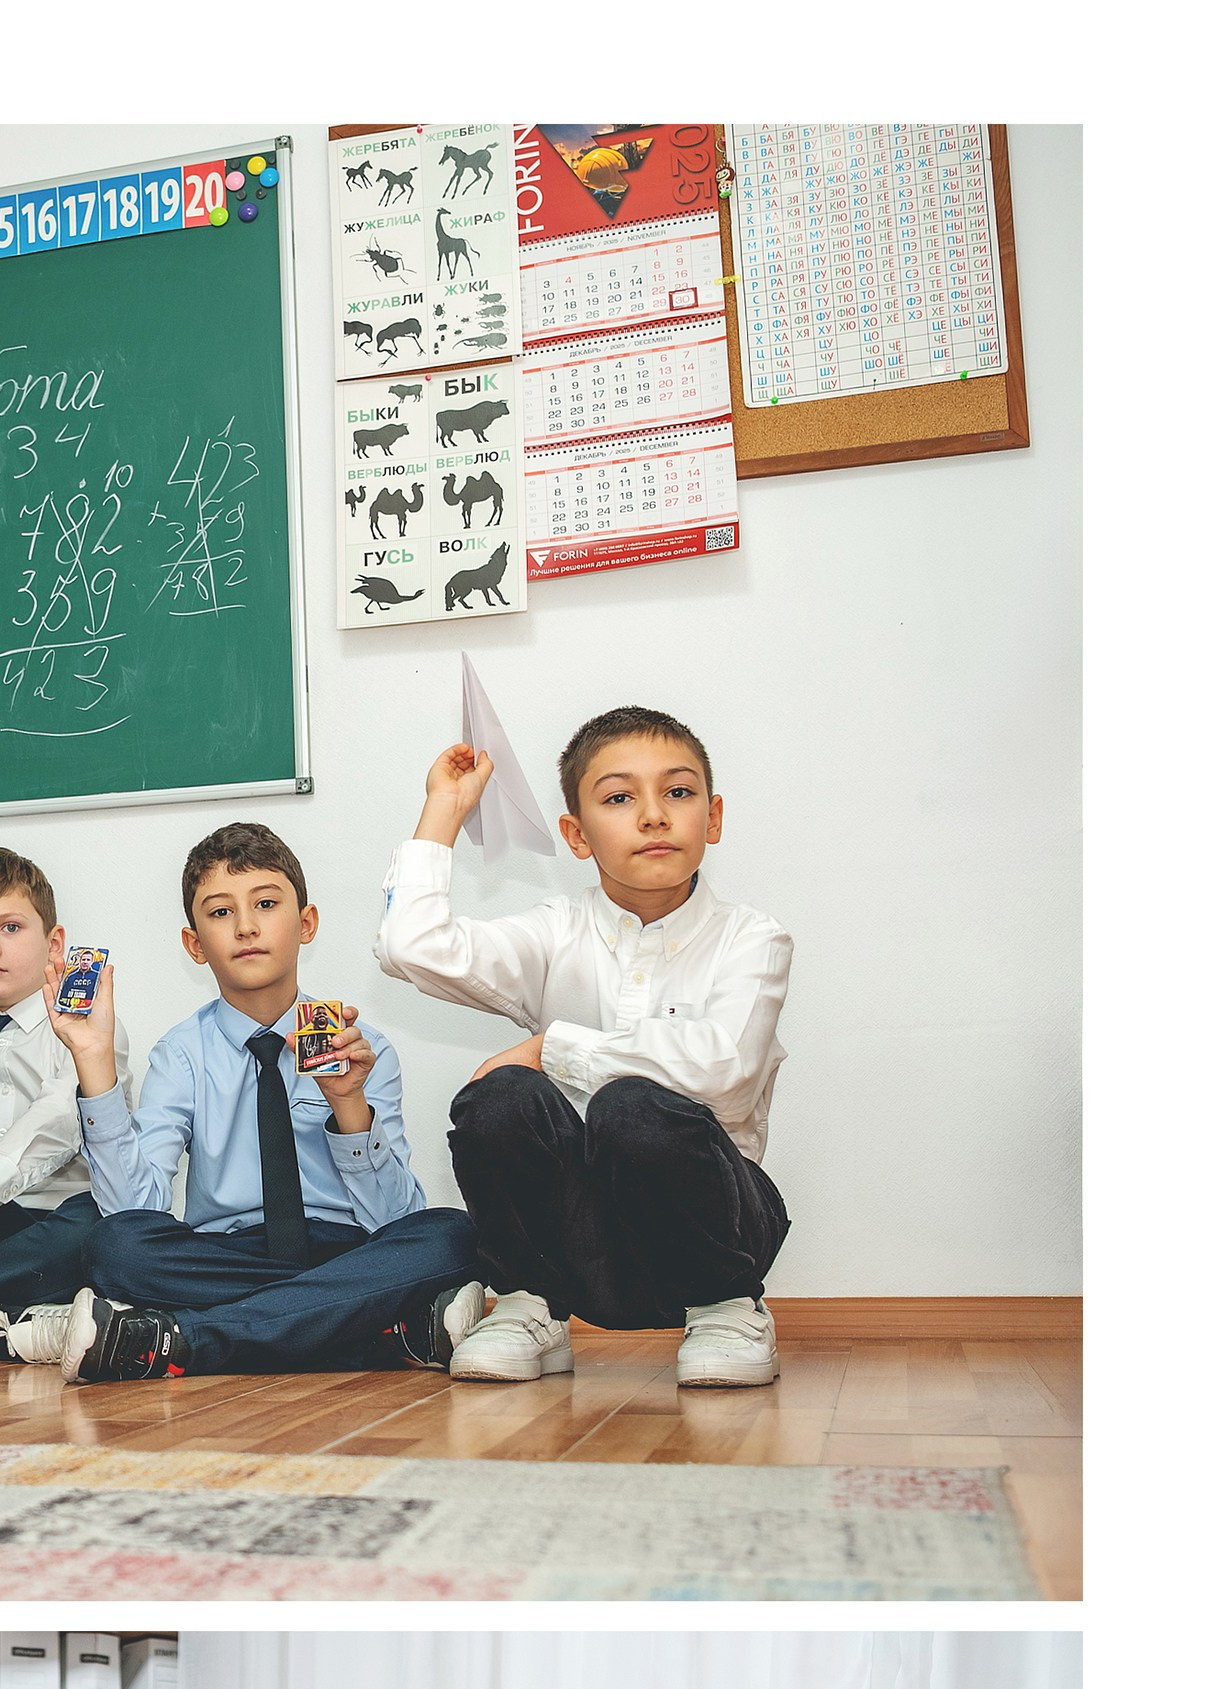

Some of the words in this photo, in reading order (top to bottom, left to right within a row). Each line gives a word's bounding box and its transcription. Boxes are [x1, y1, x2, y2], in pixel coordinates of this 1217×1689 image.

[425, 123, 501, 143] ЖЕРЕБЁНОК
[342, 137, 417, 158] ЖЕРЕБЯТА
[513, 123, 545, 235] FORIN
[21, 199, 58, 244] 16
[62, 192, 96, 237] 17
[103, 185, 139, 230] 18
[144, 178, 179, 223] 19
[184, 171, 224, 218] 20
[343, 212, 422, 234] ЖУЖЕЛИЦА
[449, 210, 506, 230] ЖИРАФ
[627, 229, 667, 242] NOVEMBER
[752, 281, 759, 291] Р
[770, 278, 783, 287] РА
[792, 273, 805, 284] РЯ
[814, 270, 827, 280] РУ
[835, 266, 851, 277] РЮ
[858, 262, 873, 273] РО
[904, 255, 918, 265] РЭ
[927, 251, 940, 262] РЕ
[949, 248, 965, 258] РЫ
[973, 245, 987, 255] РИ
[444, 280, 489, 297] ЖУКИ
[753, 295, 760, 304] С
[771, 291, 785, 301] СА
[793, 287, 806, 297] СЯ
[815, 283, 828, 294] СУ
[836, 279, 852, 290] СЮ
[860, 276, 874, 286] СО
[905, 269, 919, 279] СЭ
[928, 265, 941, 275] СЕ
[950, 261, 966, 272] СЫ
[973, 258, 988, 269] СИ
[346, 292, 424, 314] ЖУРАВЛИ
[753, 308, 760, 318] Т
[773, 305, 786, 315] ТА
[794, 301, 807, 311] ТЯ
[816, 297, 829, 307] ТУ
[837, 293, 854, 304] ТЮ
[860, 289, 875, 300] ТО
[906, 282, 920, 292] ТЭ
[929, 278, 942, 289] ТЕ
[950, 275, 967, 286] ТЫ
[974, 272, 989, 282] ТИ
[753, 322, 763, 331] Ф
[772, 319, 788, 328] ФА
[794, 314, 810, 325] ФЯ
[816, 310, 832, 321] ФУ
[837, 306, 855, 318] ФЮ
[860, 303, 878, 314] ФО
[906, 296, 922, 306] ФЭ
[929, 292, 945, 303] ФЕ
[951, 289, 969, 300] ФЫ
[974, 286, 992, 296] ФИ
[569, 348, 602, 359] ДЕКАБРЬ
[634, 335, 673, 346] DECEMBER
[444, 373, 499, 396] БЫК
[347, 406, 400, 424] БЫКИ
[435, 450, 511, 469] ВЕРБЛЮД
[573, 451, 607, 462] ДЕКАБРЬ
[615, 447, 631, 455] 2025
[639, 441, 679, 452] DECEMBER
[167, 435, 260, 509] 423
[347, 462, 428, 480] ВЕРБЛЮДЫ
[576, 472, 583, 481] 2
[598, 469, 605, 477] 3
[643, 463, 650, 471] 5
[666, 459, 673, 468] 6
[689, 456, 696, 464] 7
[554, 488, 561, 496] 8
[576, 485, 584, 493] 9
[596, 482, 610, 490] 10
[619, 478, 631, 487] 11
[642, 475, 655, 484] 12
[664, 472, 678, 481] 13
[687, 468, 700, 477] 14
[552, 500, 566, 509] 15
[575, 497, 588, 506] 16
[597, 494, 610, 503] 17
[620, 491, 633, 500] 18
[642, 488, 655, 497] 19
[664, 485, 679, 494] 20
[687, 481, 700, 491] 21
[552, 513, 566, 522] 22
[574, 510, 588, 519] 23
[597, 507, 611, 516] 24
[619, 504, 634, 513] 25
[642, 501, 656, 510] 26
[665, 497, 679, 507] 27
[688, 494, 702, 504] 28
[20, 492, 123, 564] 782
[553, 526, 567, 535] 29
[575, 523, 590, 532] 30
[597, 520, 610, 529] 31
[439, 537, 488, 553] ВОЛК
[552, 548, 588, 562] FORIN
[363, 549, 415, 567] ГУСЬ
[529, 567, 560, 576] Лучшие
[560, 563, 595, 573] решения
[595, 560, 610, 568] для
[611, 555, 639, 564] вашего
[640, 550, 672, 561] бизнеса
[673, 546, 698, 556] online
[3, 646, 110, 712] 423
